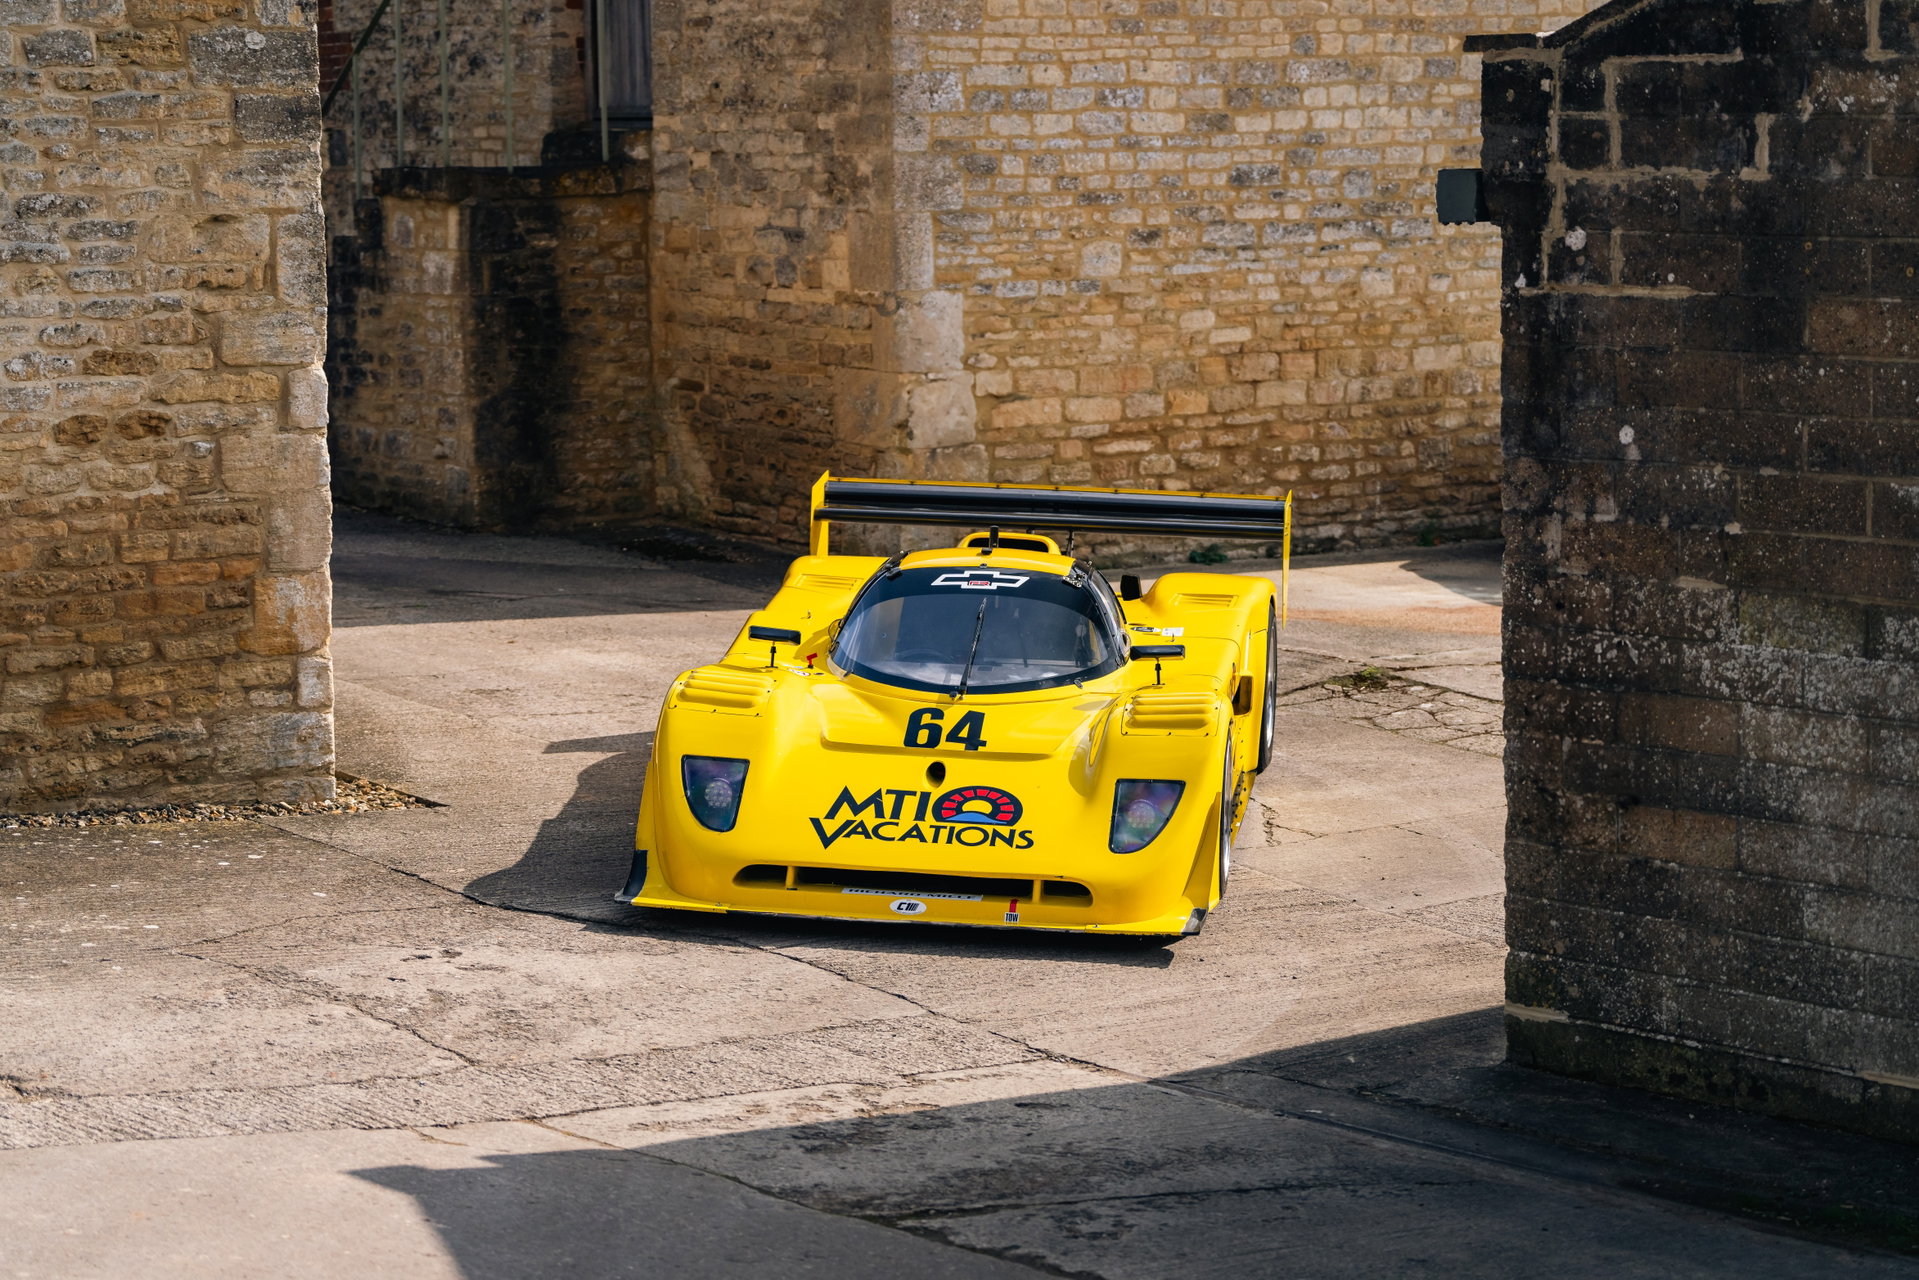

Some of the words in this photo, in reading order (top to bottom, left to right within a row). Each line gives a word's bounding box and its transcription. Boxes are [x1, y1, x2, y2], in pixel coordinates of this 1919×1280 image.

[903, 707, 987, 751] 64
[823, 785, 932, 822] MTI
[809, 813, 1035, 850] VACATIONS
[1005, 913, 1019, 922] TOW
